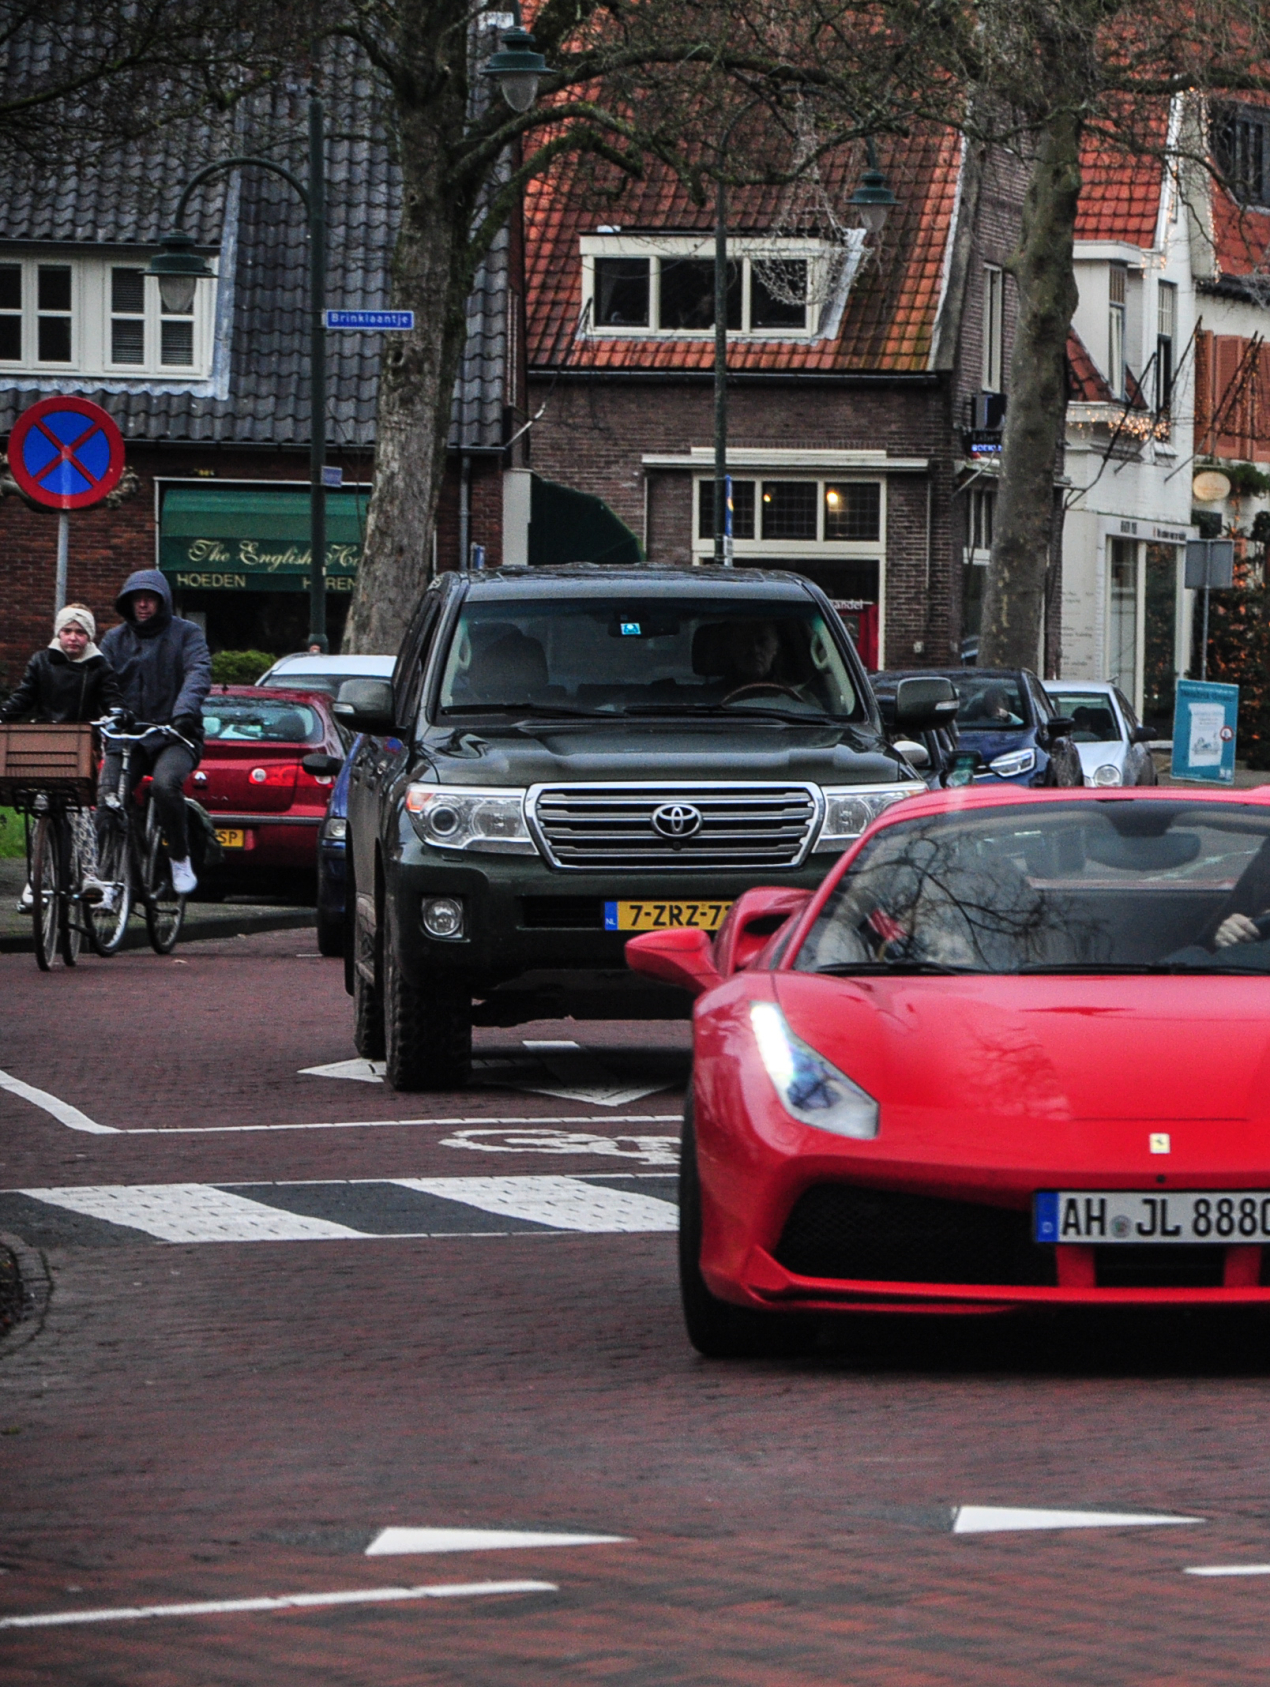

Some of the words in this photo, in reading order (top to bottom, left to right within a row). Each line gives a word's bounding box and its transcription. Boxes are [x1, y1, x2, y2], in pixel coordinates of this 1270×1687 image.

[331, 313, 408, 326] Brinklaantje
[188, 539, 230, 562] The
[236, 540, 313, 573] English
[176, 573, 246, 588] HOEDEN
[303, 576, 357, 591] HREN
[831, 599, 863, 610] andel
[629, 905, 732, 926] 7-ZRZ-7
[1062, 1198, 1106, 1236] AH
[1136, 1198, 1182, 1236] JL
